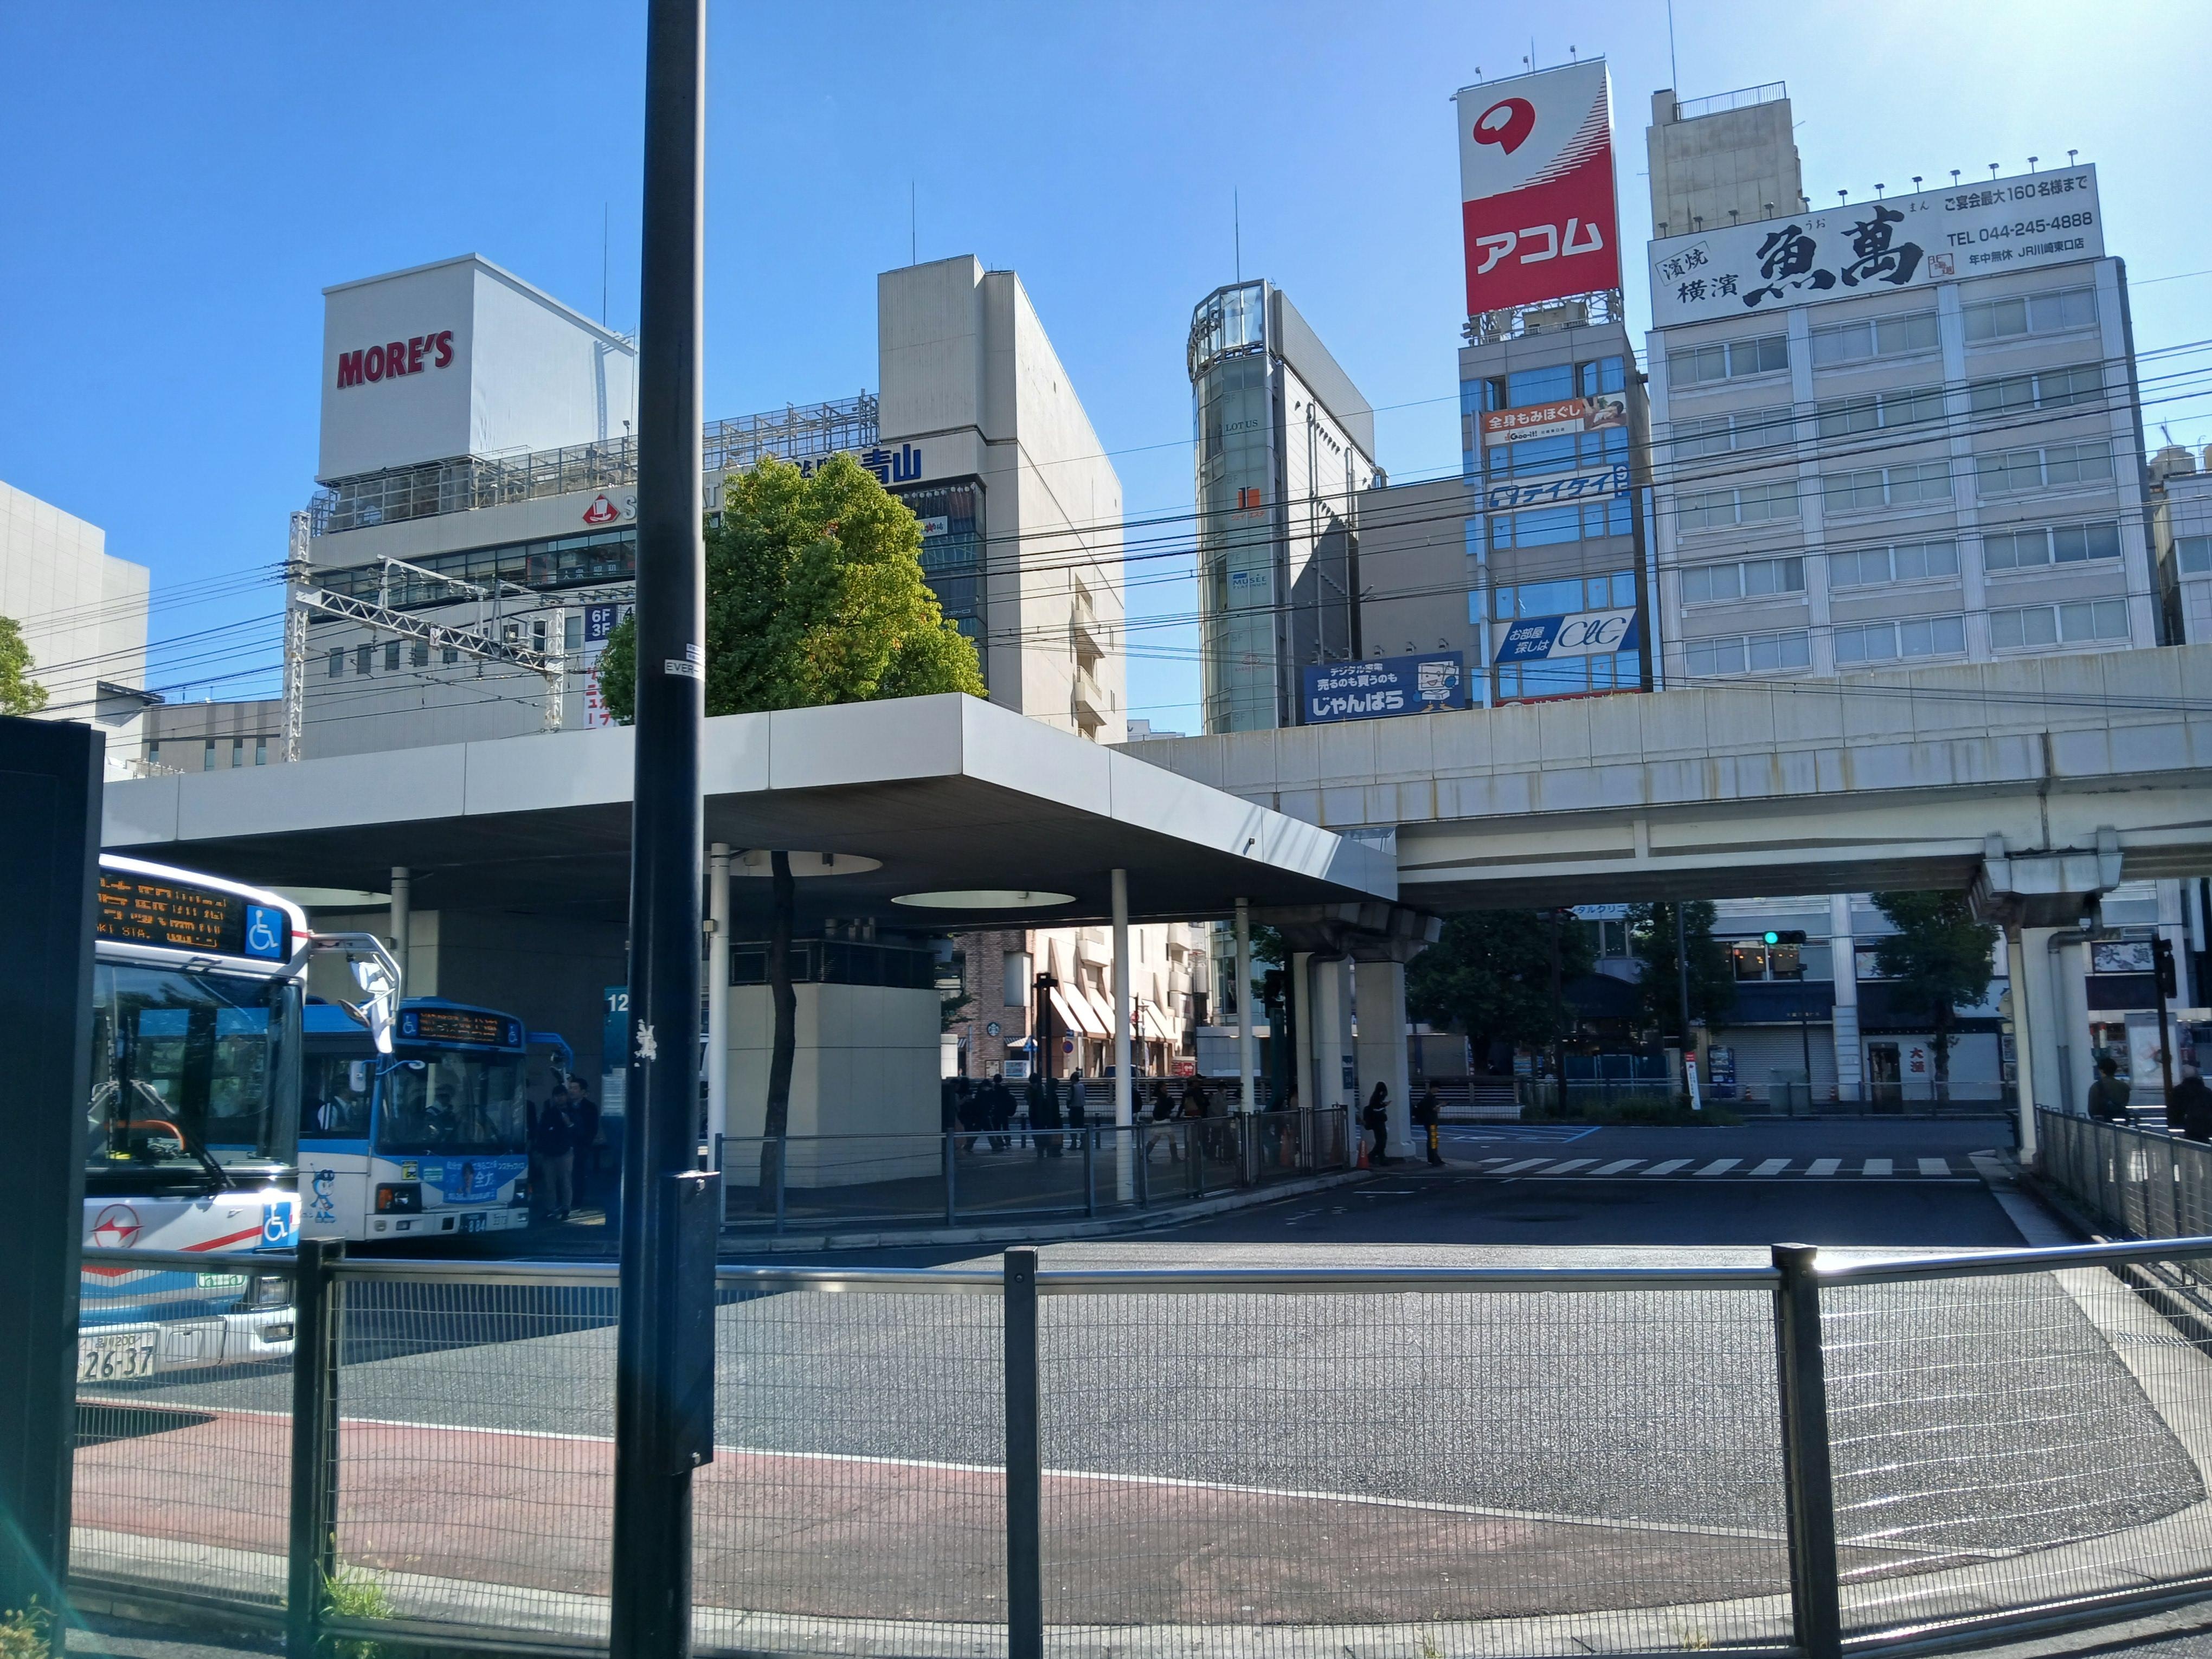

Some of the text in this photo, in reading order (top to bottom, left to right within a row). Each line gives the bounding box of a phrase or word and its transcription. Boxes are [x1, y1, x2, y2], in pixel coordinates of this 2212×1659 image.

[1945, 176, 2087, 211] ご宴会最大160名様まで
[1947, 212, 2092, 246] TEL 044-245-4888
[1476, 217, 1603, 274] アコム
[1742, 205, 1924, 307] 魚萬
[1969, 237, 2084, 265] 年中無休 JR川崎東口店
[336, 330, 454, 389] MORE'S
[1225, 420, 1258, 432] LOTUS
[1489, 404, 1580, 429] 全身もみほぐし
[591, 608, 610, 622] 6F
[591, 622, 610, 637] 3F
[1509, 626, 1545, 641] お部屋
[1514, 640, 1550, 654] 探しは
[1317, 673, 1398, 691] 売るのも買うのも
[1313, 690, 1404, 716] じゃんぱら
[608, 994, 629, 1012] 12
[84, 1346, 154, 1378] 26-37
